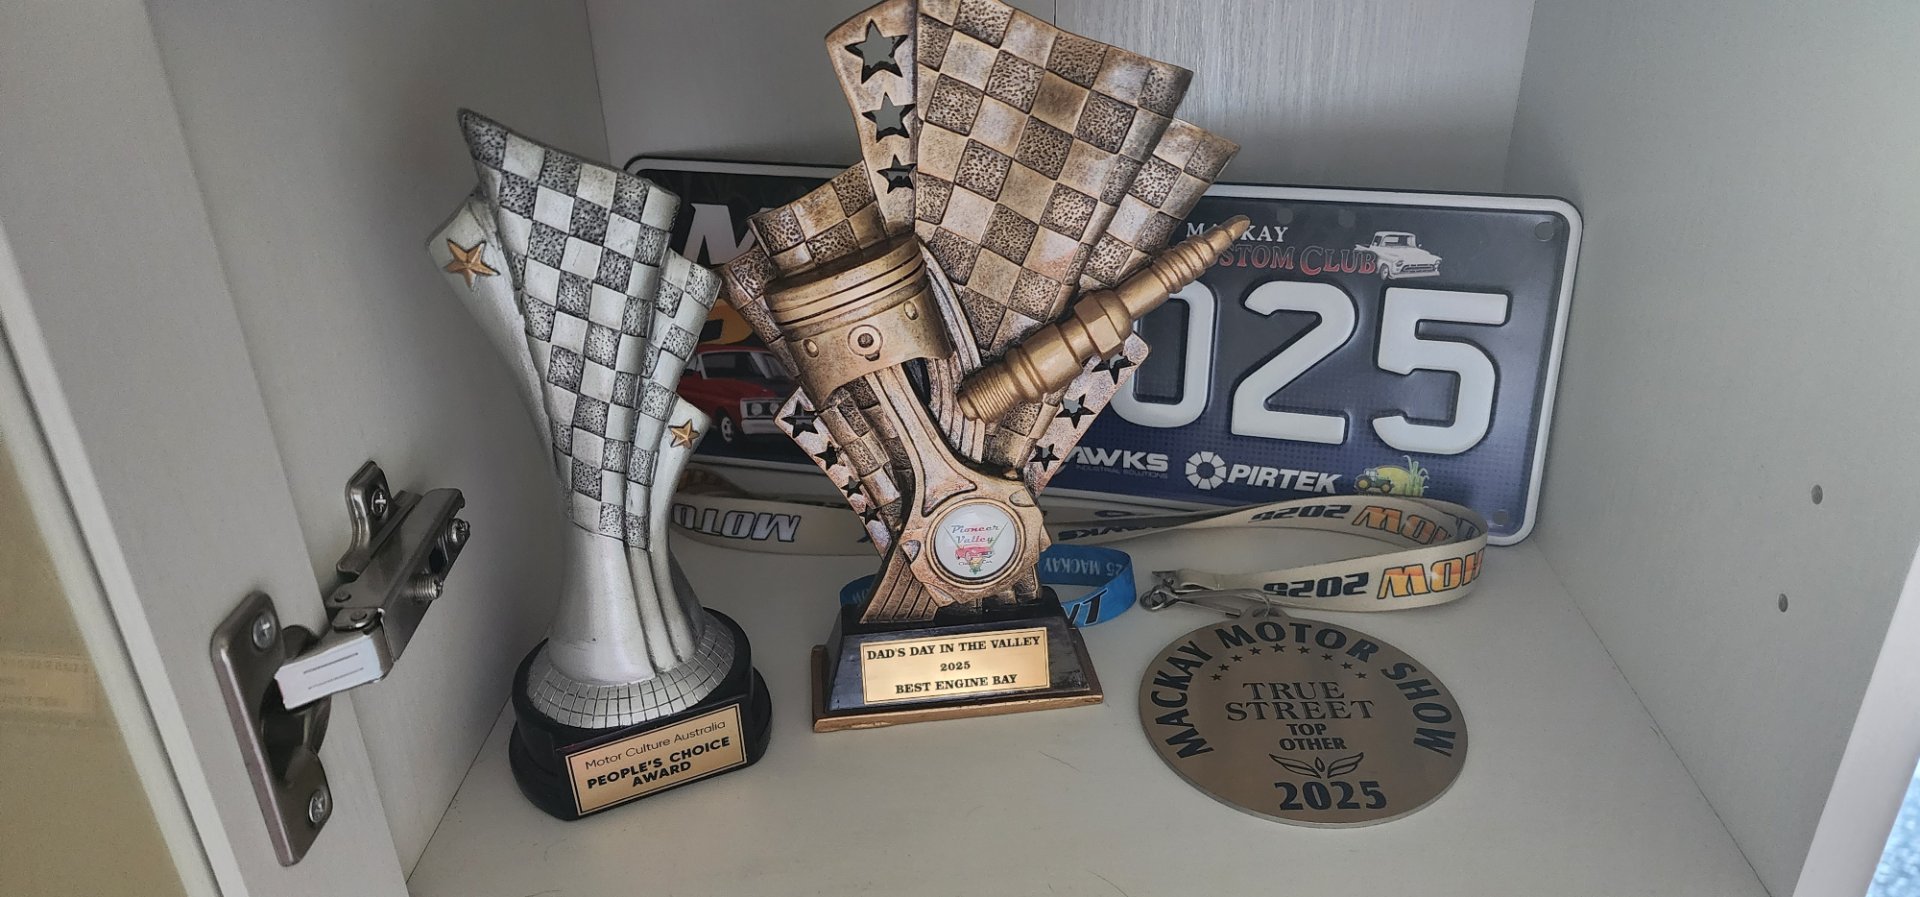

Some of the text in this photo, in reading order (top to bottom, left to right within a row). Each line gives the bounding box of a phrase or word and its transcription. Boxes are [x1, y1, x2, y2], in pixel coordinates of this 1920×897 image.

[1187, 222, 1289, 243] MKAY
[1218, 244, 1378, 276] STOM CLUB
[1110, 280, 1510, 455] 025
[1064, 446, 1169, 473] AWKS
[1226, 463, 1343, 494] PIRTEK
[672, 503, 802, 543] MOTO
[951, 524, 1000, 534] Pioneer
[956, 535, 994, 545] Valley
[1044, 557, 1124, 577] 25 MACKAY
[1263, 549, 1485, 600] HOW 2025
[867, 635, 1041, 660] DAD'S DAY IN THE VALLEY
[940, 661, 971, 672] 2025
[895, 674, 1018, 694] BEST ENGINE BAY
[1151, 621, 1457, 759] MACKAY MOTOR SHOW
[1242, 682, 1345, 700] TRUE
[1226, 700, 1375, 722] STREET
[1286, 723, 1327, 736] TOP
[585, 720, 726, 770] Motor Culture Australia
[1279, 737, 1347, 751] OTHER
[587, 736, 731, 789] PEOPLE'S CHOICE
[632, 761, 692, 788] AWARD
[1274, 781, 1387, 811] 2025
